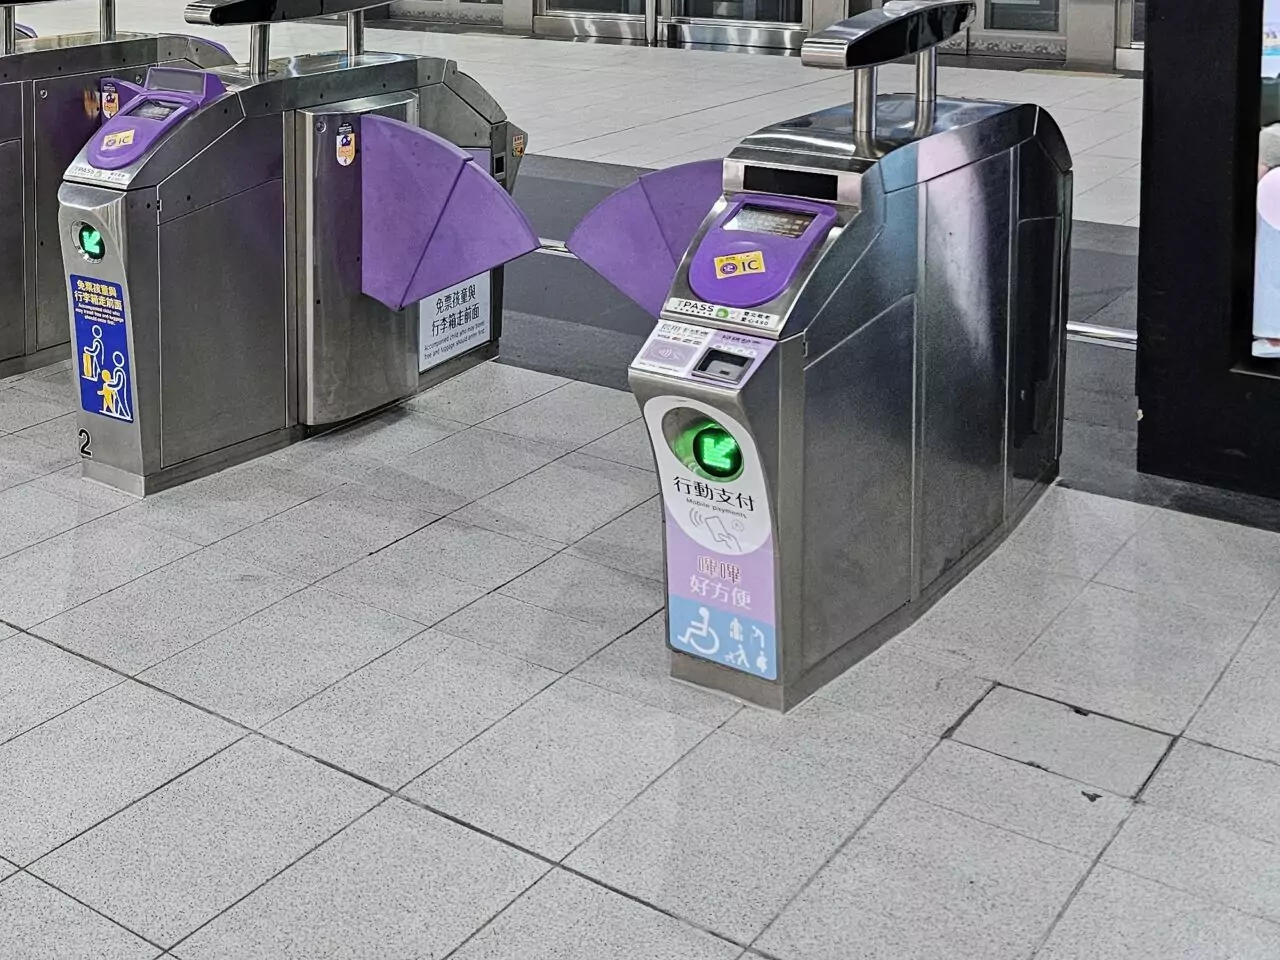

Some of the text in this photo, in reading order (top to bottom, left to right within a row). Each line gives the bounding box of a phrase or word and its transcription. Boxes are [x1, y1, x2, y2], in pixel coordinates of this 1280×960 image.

[119, 136, 130, 144] IC
[741, 260, 759, 271] IC
[436, 284, 476, 316] 免票孩童與
[677, 300, 715, 312] TPASS
[432, 302, 480, 337] 行李箱走前面
[78, 428, 92, 457] 2
[673, 476, 755, 512] 行動支付
[690, 575, 751, 610] 好方便
